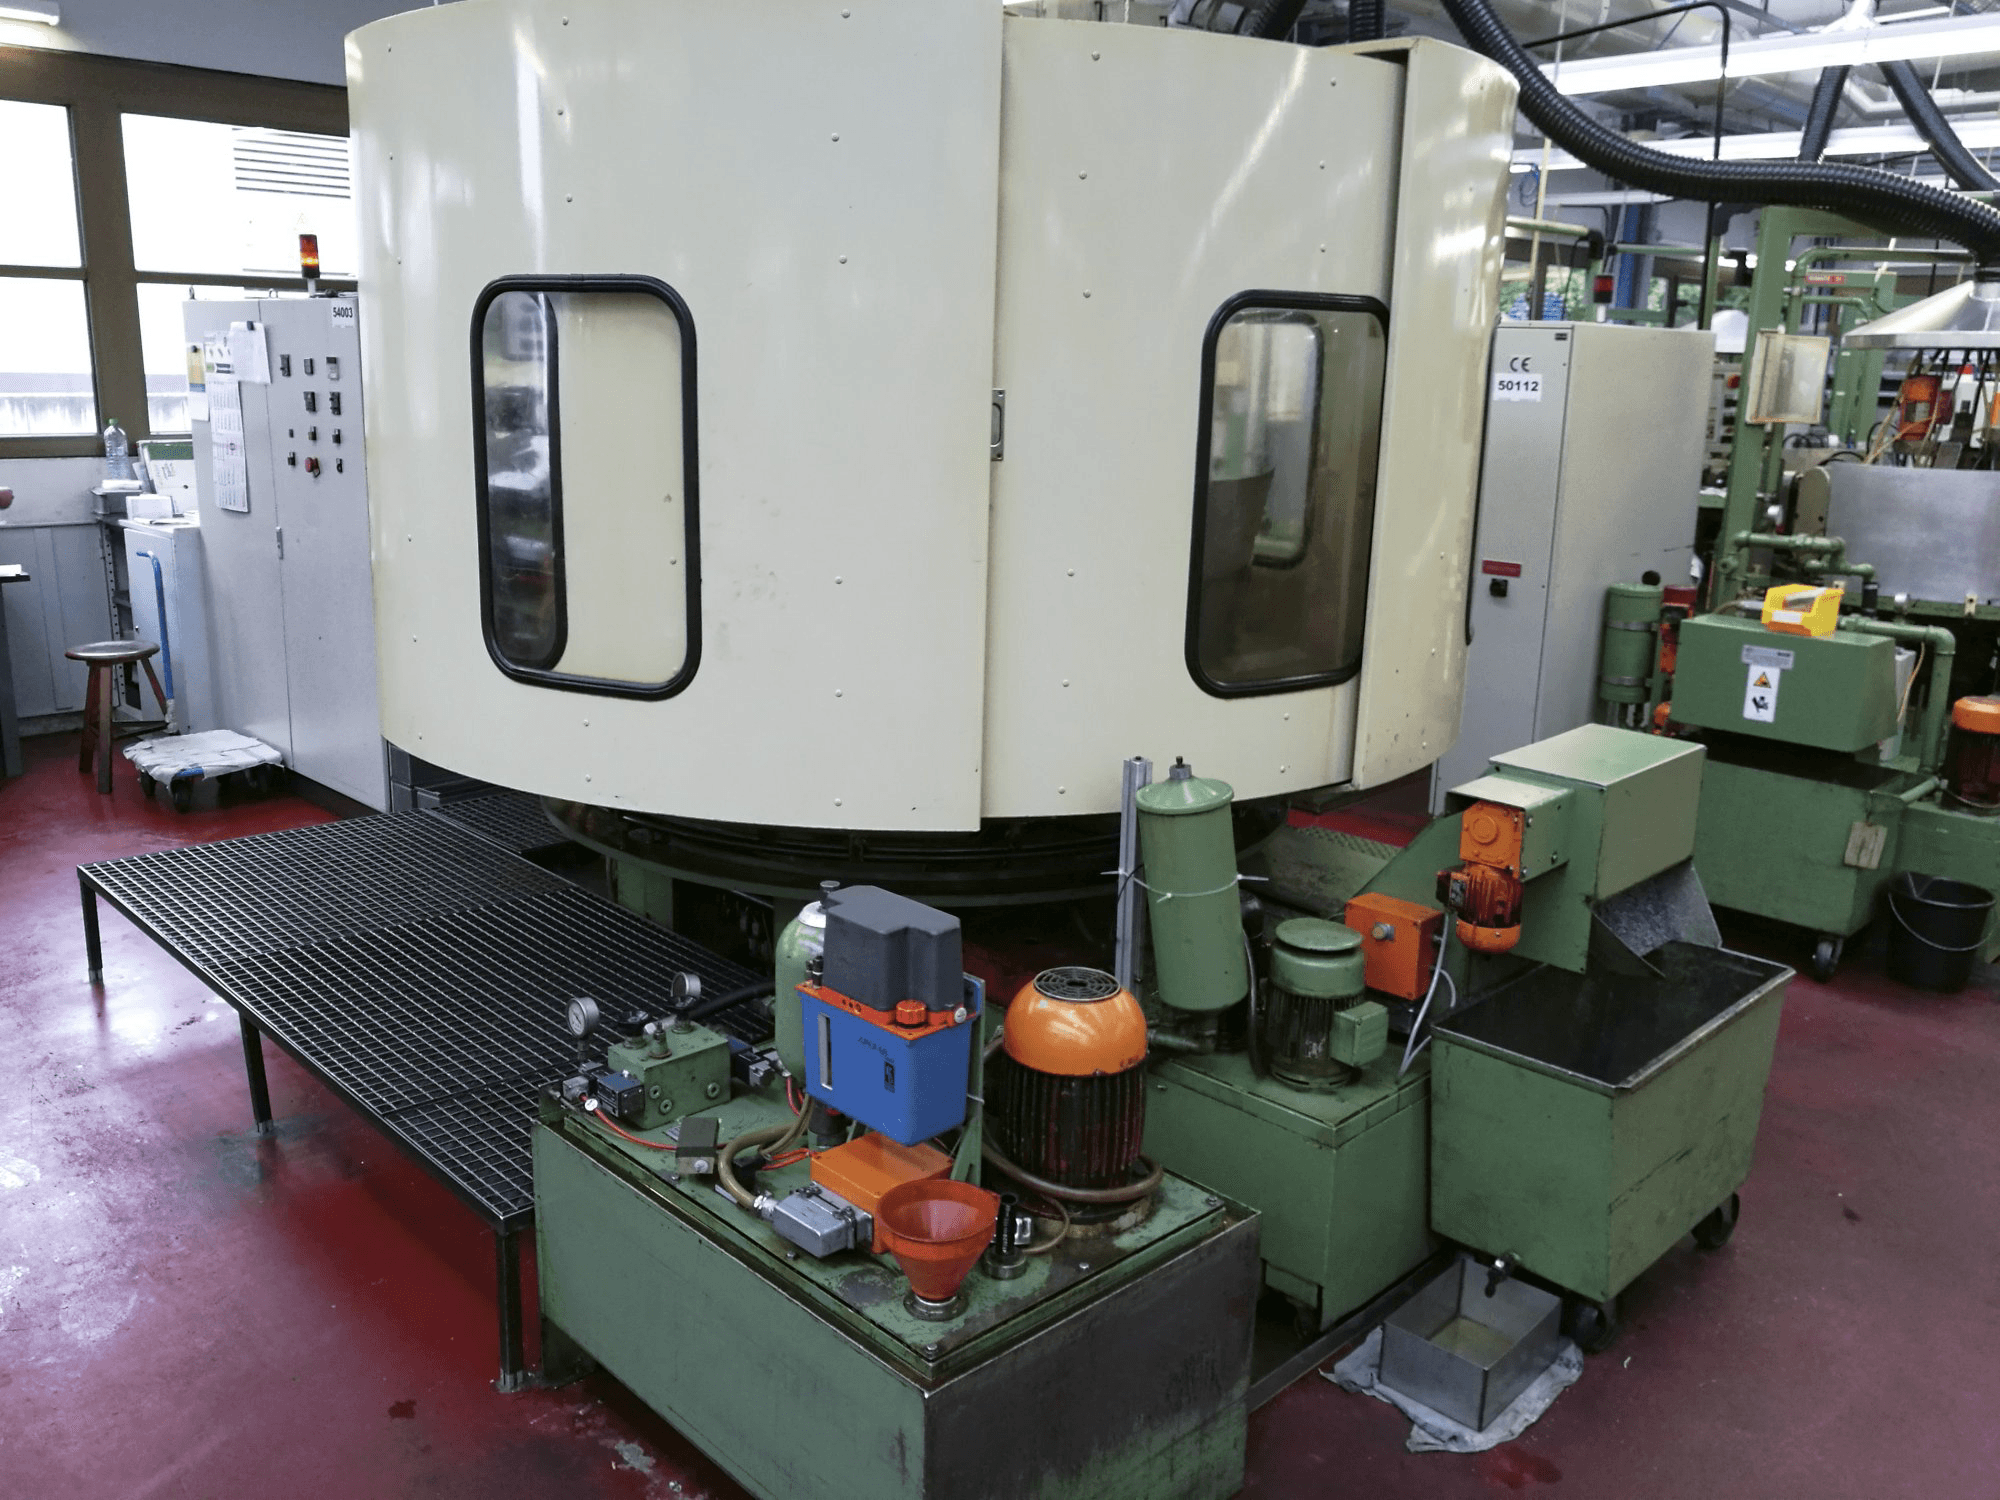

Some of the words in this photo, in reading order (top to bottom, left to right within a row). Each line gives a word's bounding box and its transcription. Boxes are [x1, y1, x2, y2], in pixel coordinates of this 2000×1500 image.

[333, 306, 353, 318] 54003
[1509, 357, 1532, 373] CE
[1498, 380, 1539, 392] 50112
